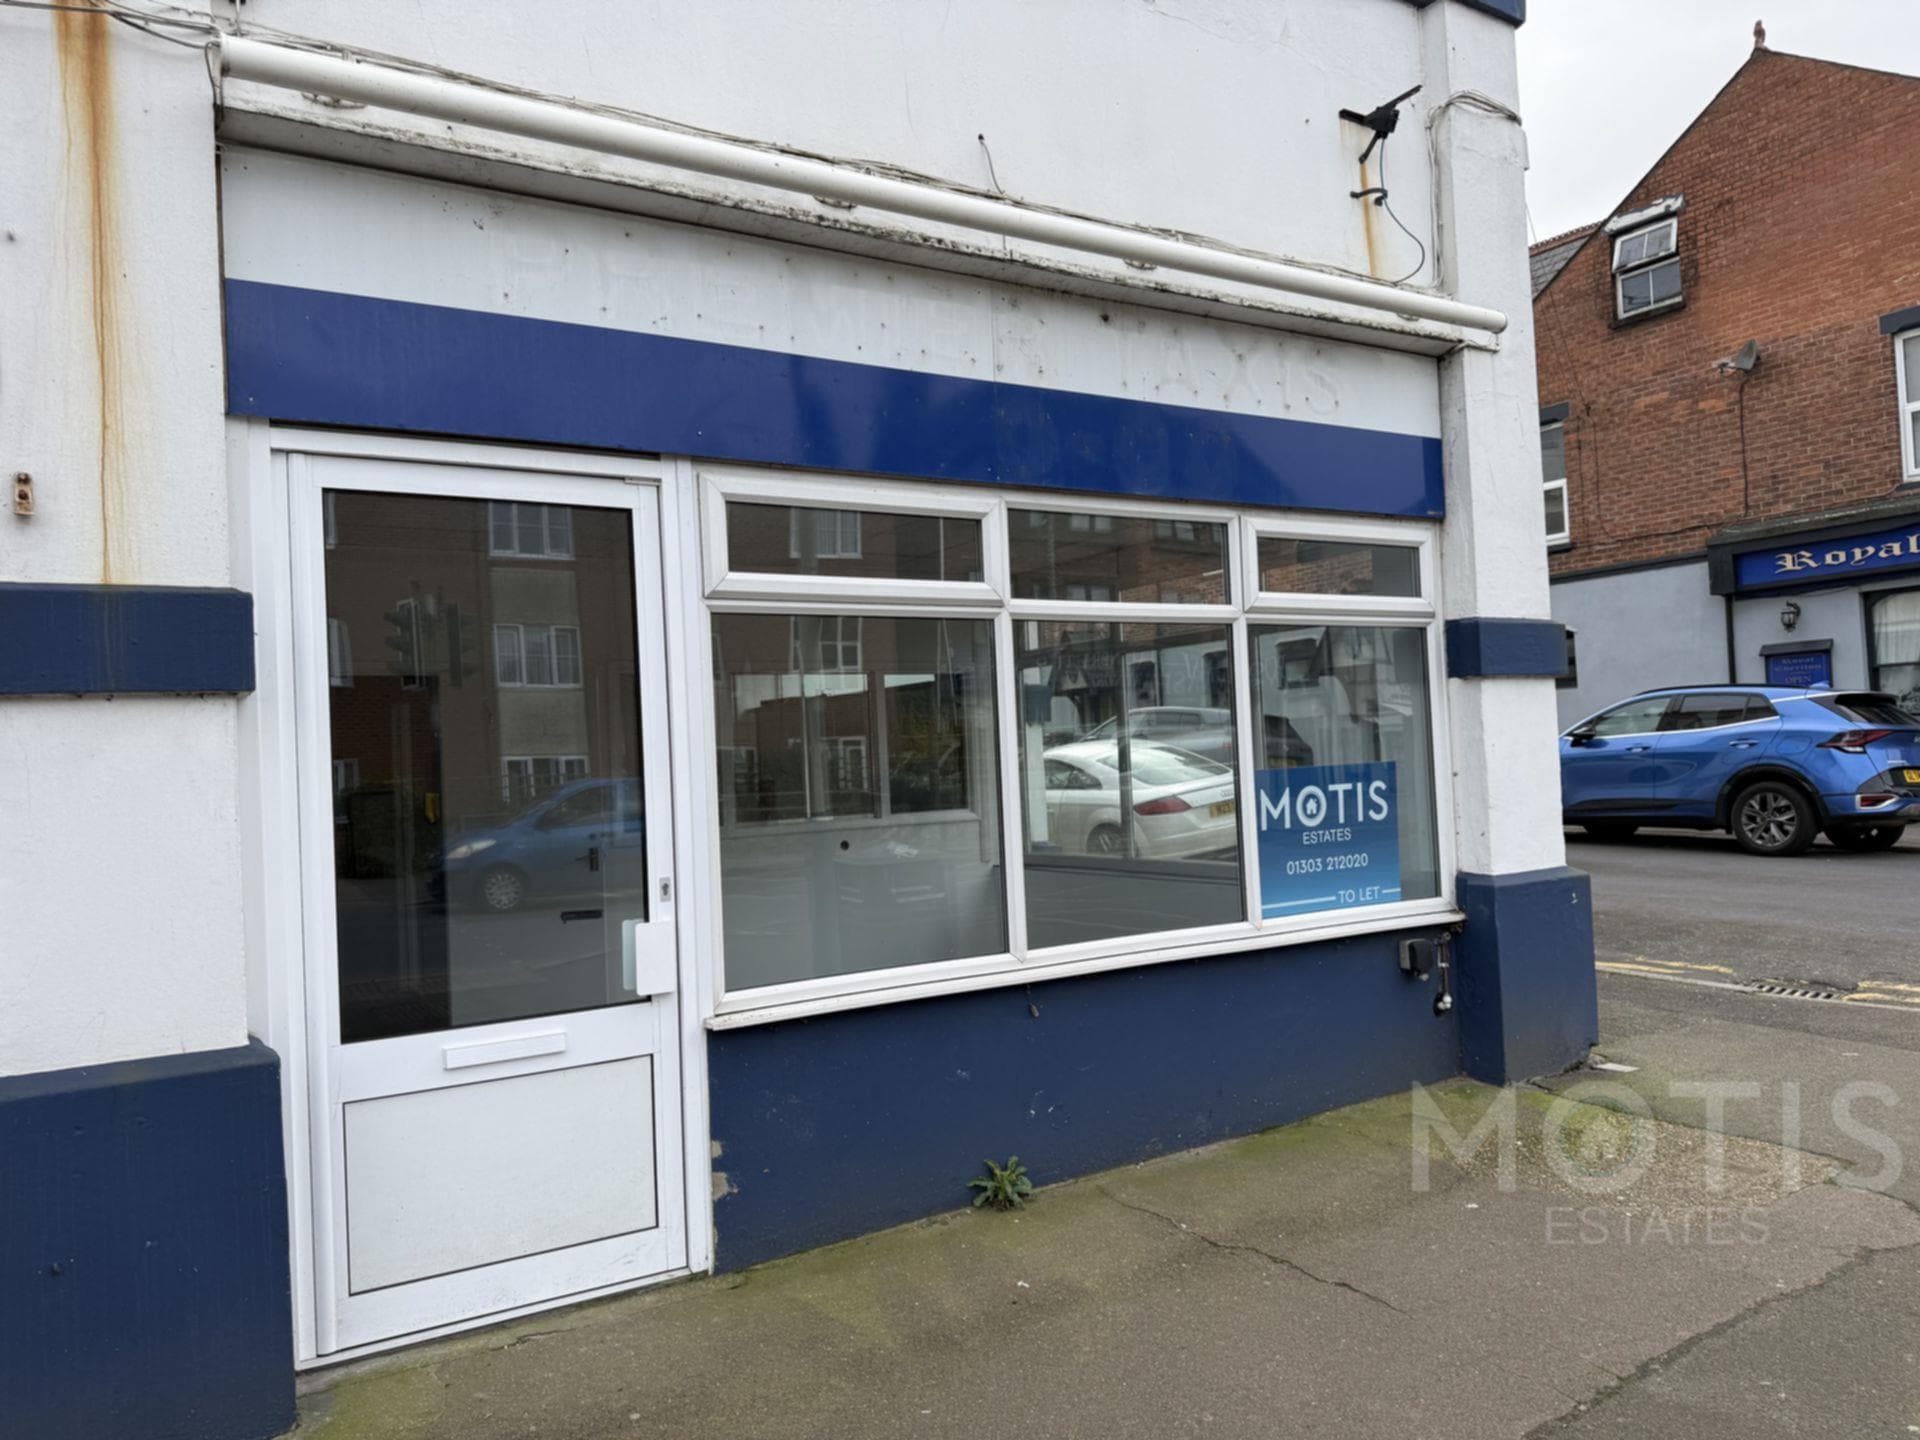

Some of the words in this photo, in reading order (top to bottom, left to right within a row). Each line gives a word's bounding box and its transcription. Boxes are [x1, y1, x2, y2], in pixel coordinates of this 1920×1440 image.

[1775, 533, 1920, 574] Royal
[1260, 780, 1389, 831] MOTIS
[1302, 828, 1352, 844] ESTATES
[1286, 858, 1322, 875] 01303
[1326, 853, 1369, 871] 212020
[1338, 889, 1355, 903] TO
[1359, 886, 1380, 901] LET
